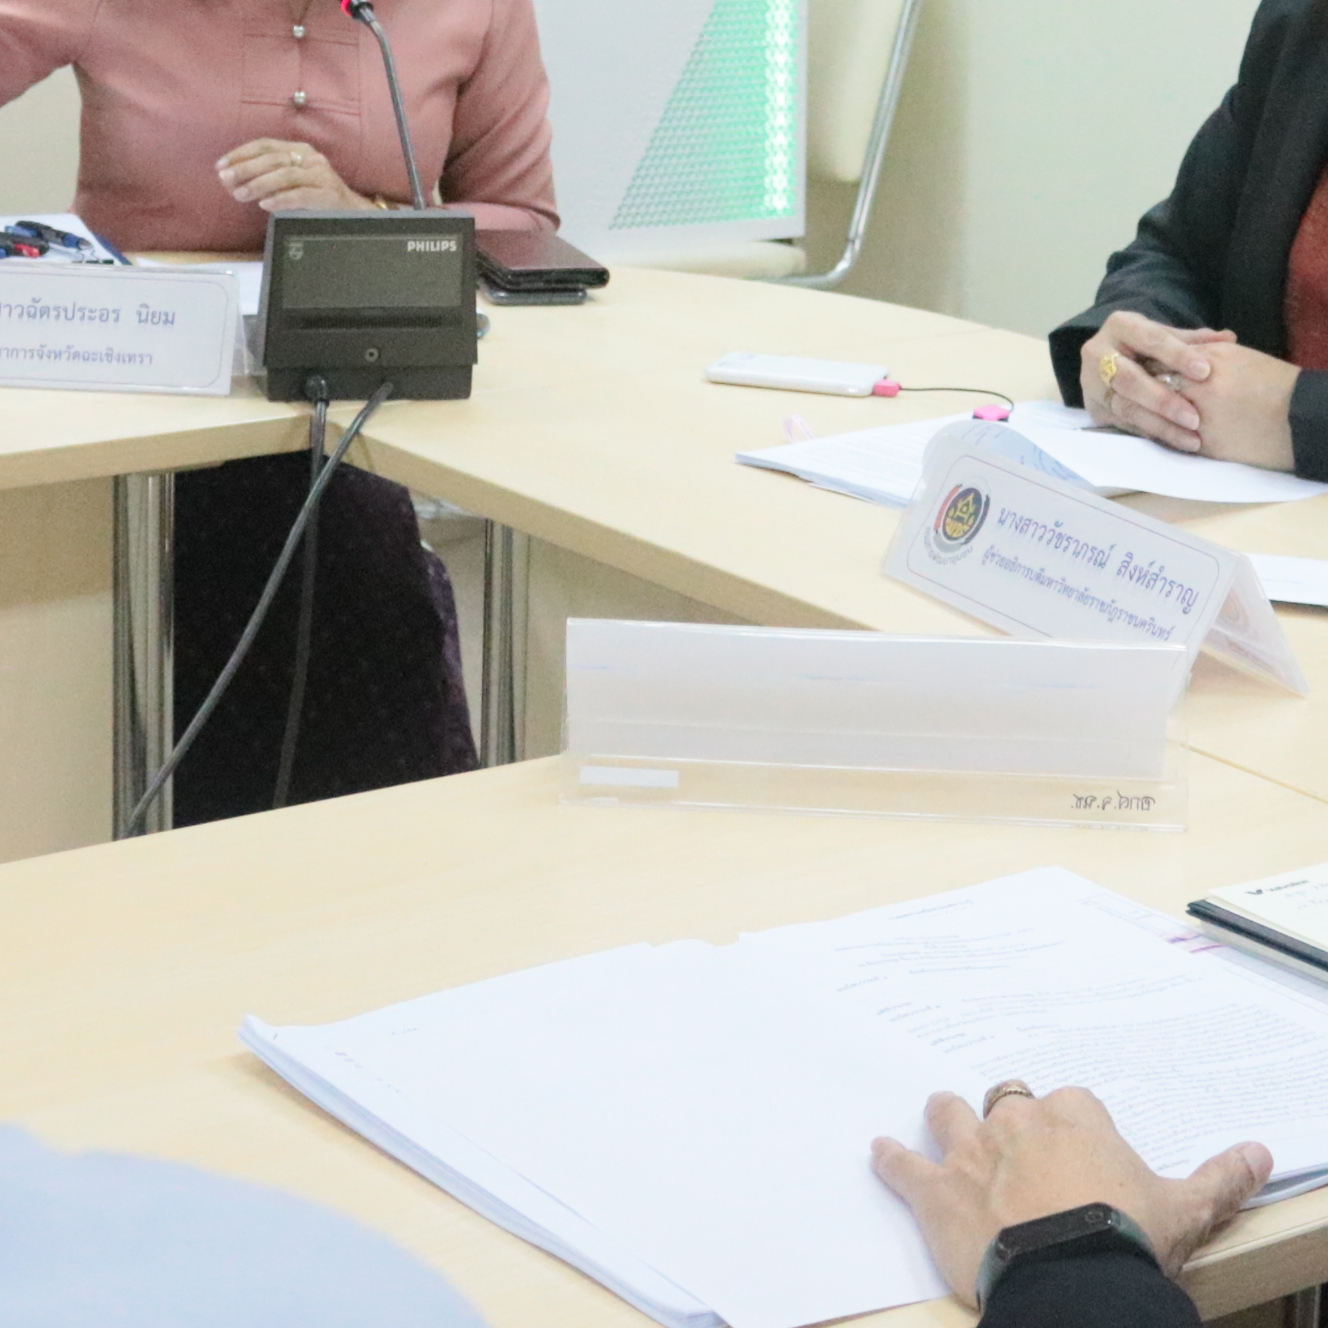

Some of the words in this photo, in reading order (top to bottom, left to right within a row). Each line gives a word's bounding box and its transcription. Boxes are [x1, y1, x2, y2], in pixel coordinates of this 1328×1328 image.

[407, 240, 457, 252] PHILIPS
[135, 302, 177, 326] นิยม
[997, 508, 1117, 570] นางสาววัชราภรณ์
[1116, 550, 1200, 615] สิงห์สำราญ
